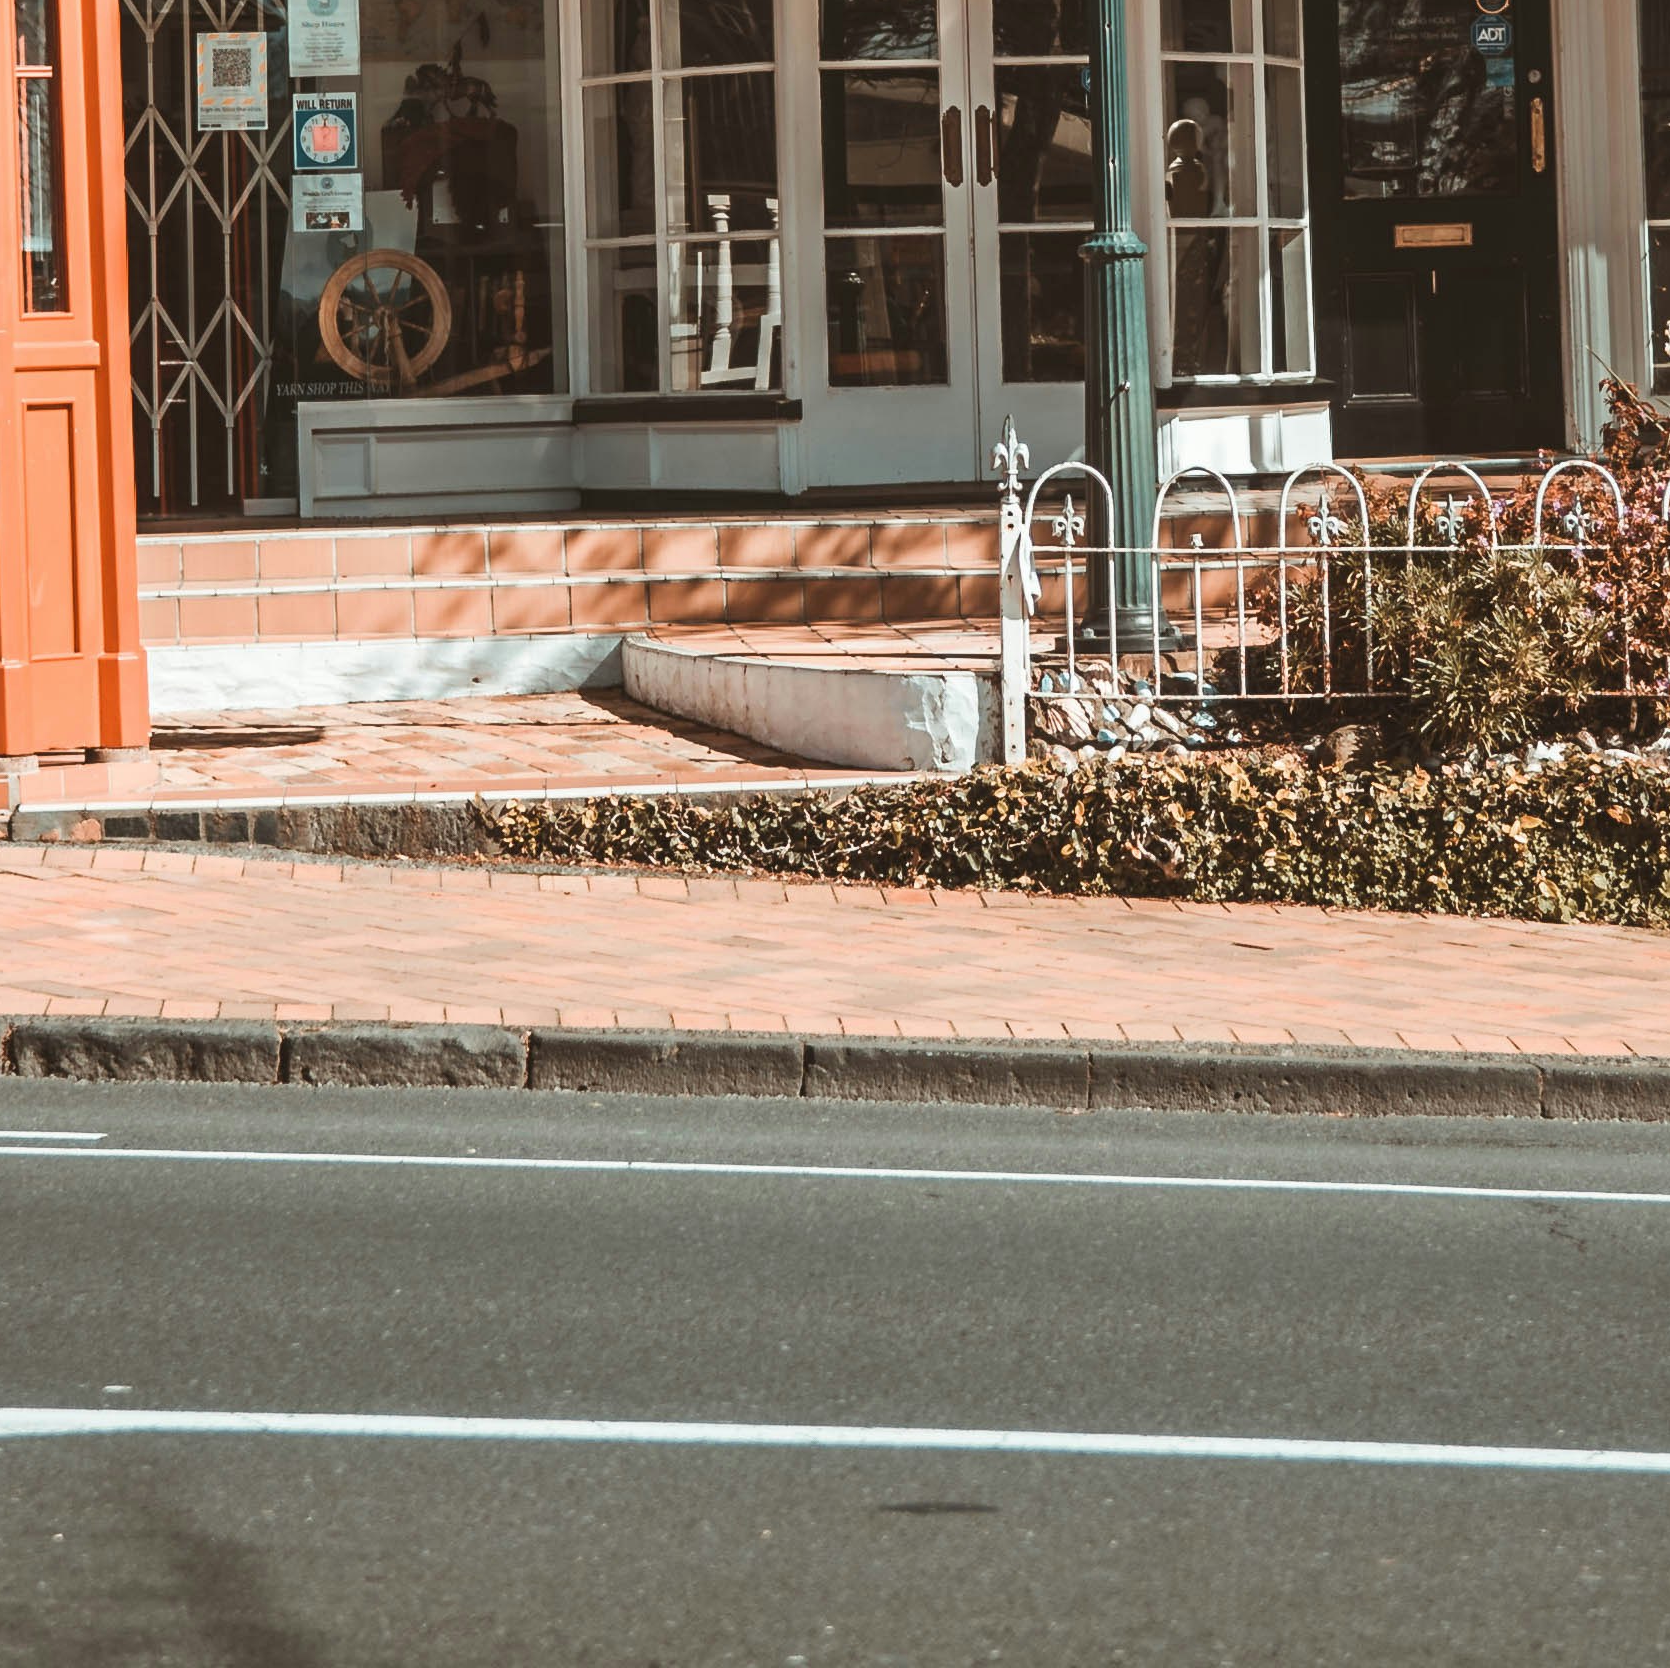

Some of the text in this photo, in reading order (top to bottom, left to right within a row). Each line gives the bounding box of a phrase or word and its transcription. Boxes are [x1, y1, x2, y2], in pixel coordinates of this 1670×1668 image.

[1477, 27, 1507, 43] ADT
[296, 99, 353, 110] WILL RETURN
[276, 383, 305, 396] YARN
[307, 381, 337, 396] SHOP
[339, 380, 364, 395] THIS
